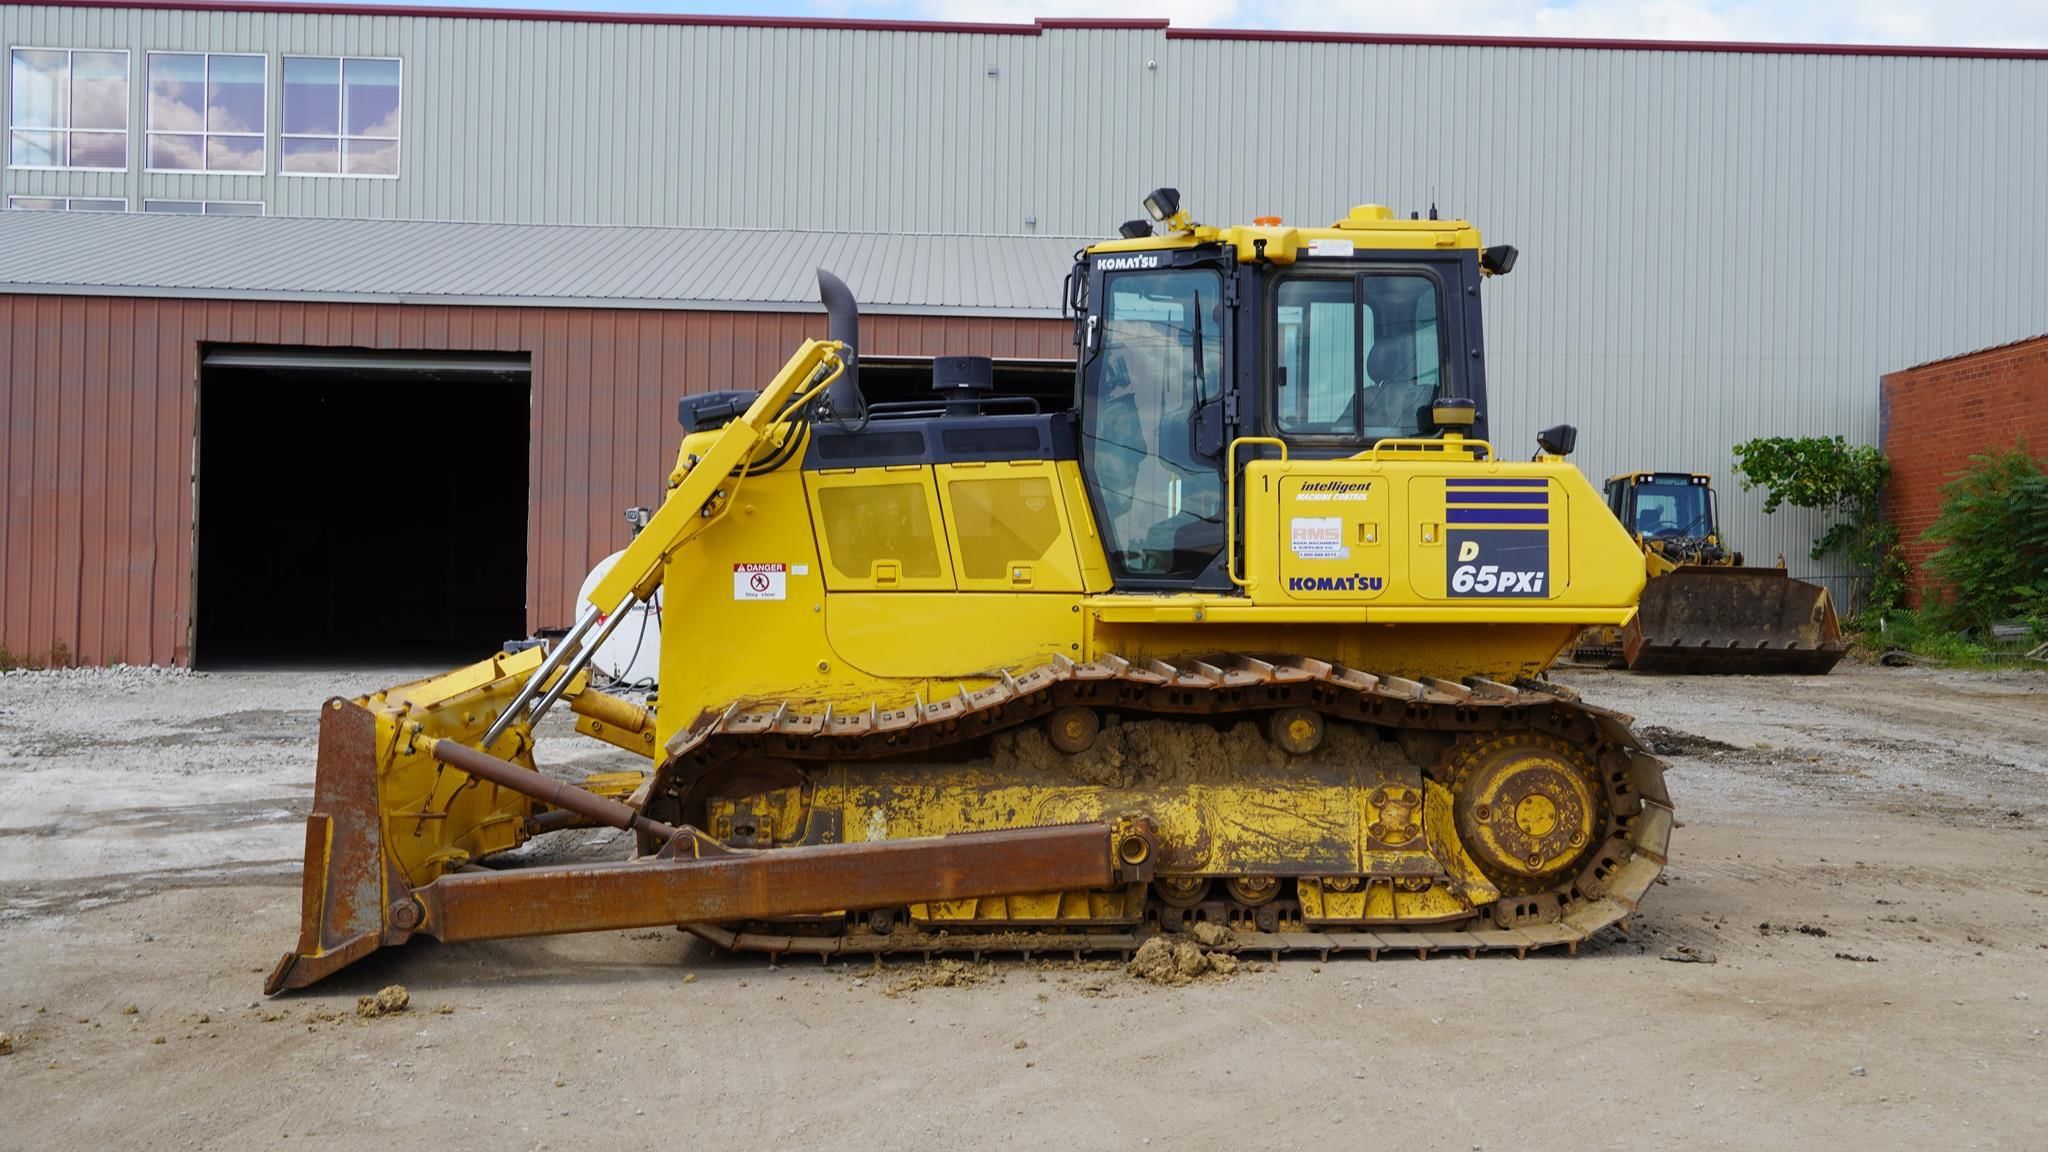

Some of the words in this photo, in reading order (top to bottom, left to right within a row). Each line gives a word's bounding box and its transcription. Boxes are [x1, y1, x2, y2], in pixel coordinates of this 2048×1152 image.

[1097, 254, 1158, 270] KOMATSU
[1262, 474, 1269, 493] 1
[1300, 481, 1372, 493] intelligent
[1295, 493, 1331, 501] MACHINE
[1332, 493, 1369, 501] CONTROL
[1292, 527, 1340, 541] RMS
[1458, 540, 1479, 562] D
[746, 563, 783, 572] DANGER
[1288, 573, 1383, 591] KOMATSU
[1451, 564, 1545, 593] 65PXi
